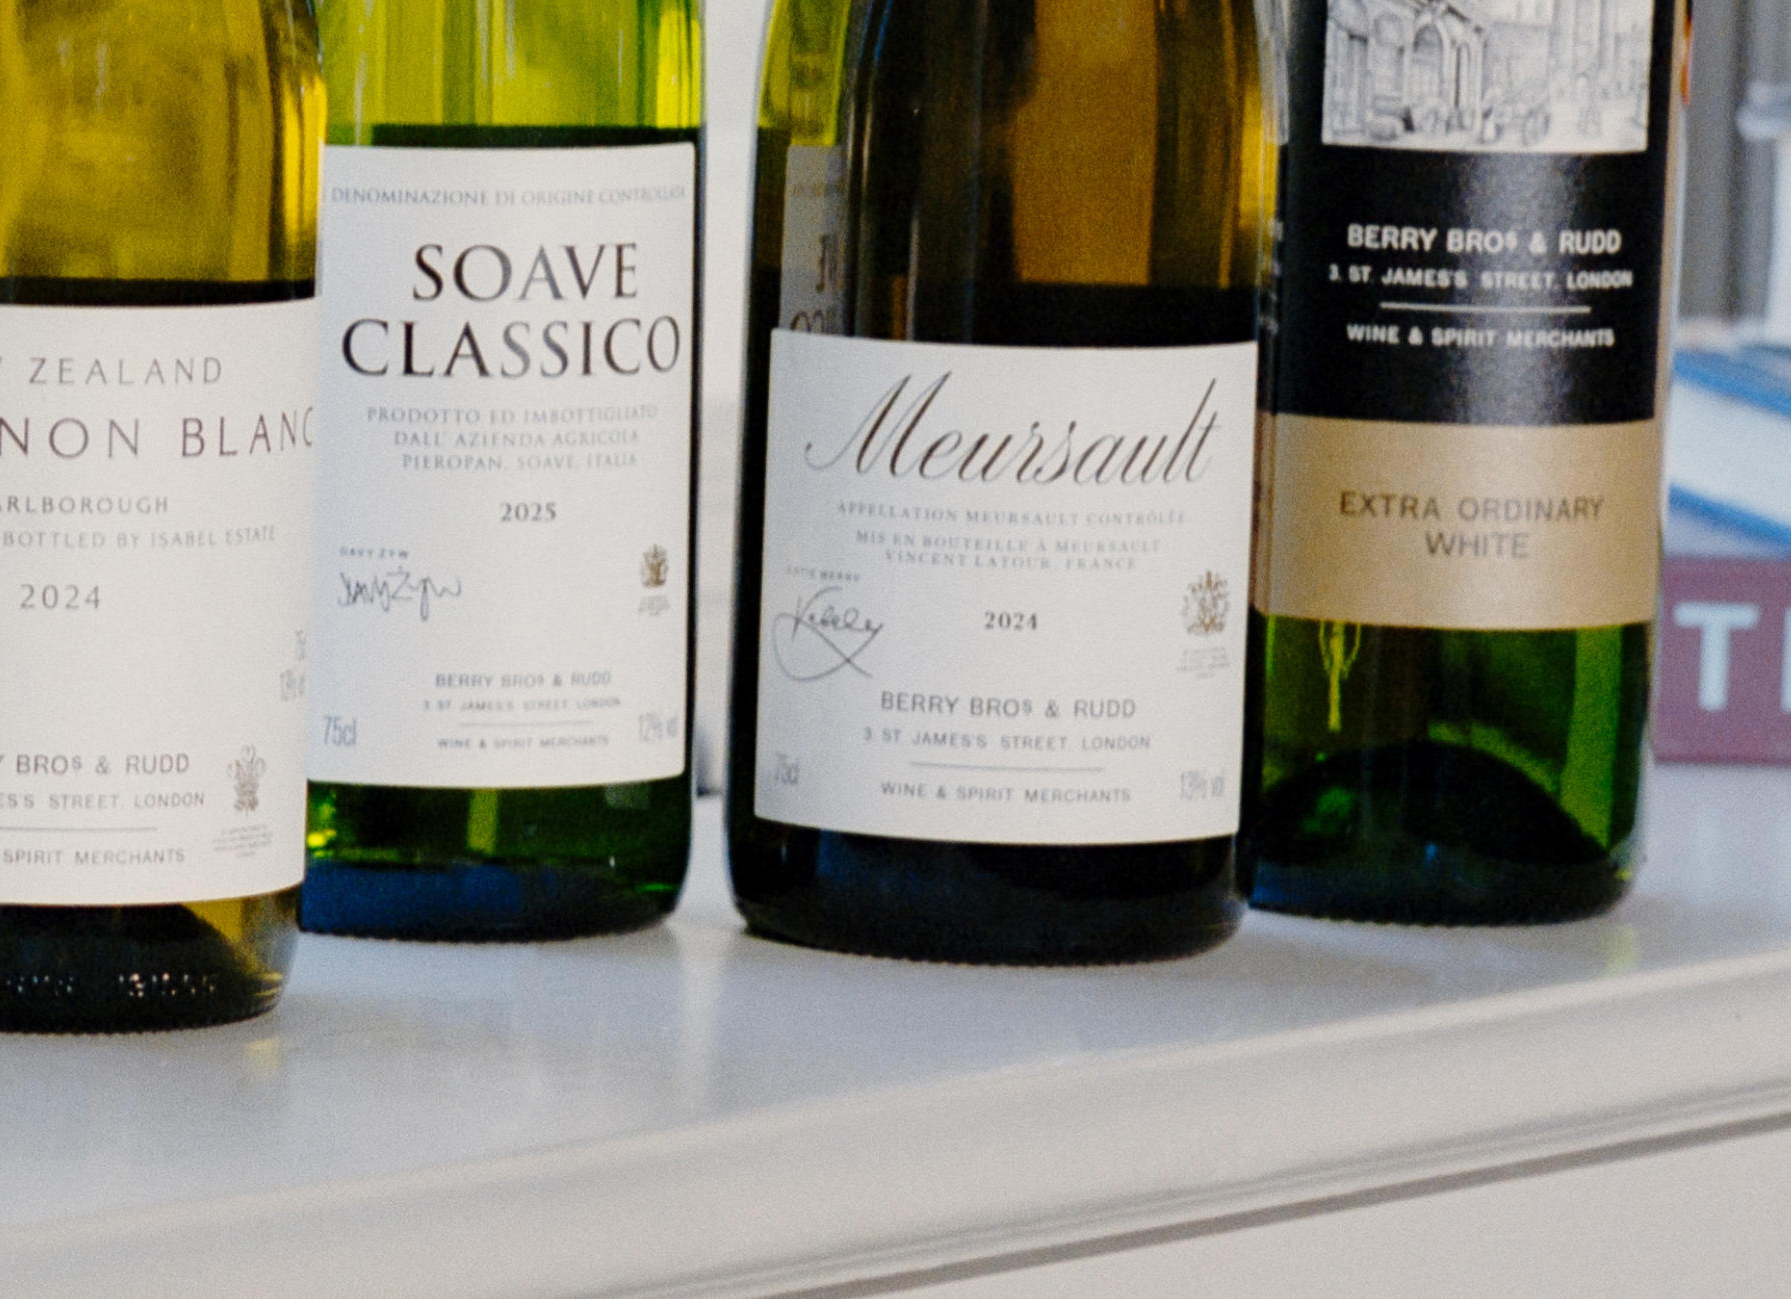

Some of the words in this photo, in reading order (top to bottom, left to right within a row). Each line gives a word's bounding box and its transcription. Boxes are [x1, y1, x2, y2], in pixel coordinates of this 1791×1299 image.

[331, 187, 488, 206] DENOMINAZIONE
[496, 190, 515, 206] DI
[521, 189, 595, 207] ORIGINE
[599, 184, 686, 203] CONTROLLATA
[1347, 223, 1438, 252] BERRY
[1529, 232, 1546, 254] &
[1559, 230, 1622, 254] RUDD
[413, 242, 638, 301] SOAVE
[1567, 270, 1633, 289] LONDON
[341, 315, 681, 378] CLASSICO
[1347, 324, 1399, 344] WINE
[1409, 326, 1423, 345] &
[1431, 327, 1496, 346] SPIRIT
[1506, 329, 1615, 347] MERCHANTS
[29, 357, 222, 385] ZEALAND
[367, 406, 480, 425] PRODOTTO
[490, 410, 515, 424] ED
[524, 404, 658, 424] IMBOTTIGLIATO
[181, 406, 313, 458] BLANC
[455, 432, 545, 447] AZIENDA
[552, 429, 639, 446] AGRICOLA
[805, 371, 1221, 485] Meursault
[586, 452, 638, 468] ITALIA
[500, 502, 557, 523] 2025
[837, 499, 958, 522] APPELLATION
[966, 509, 1078, 526] MEURSAULT
[1340, 491, 1442, 521] EXTRA
[1458, 497, 1604, 523] ORDINARY
[3, 530, 106, 548] BOTTLED
[117, 531, 139, 548] BY
[150, 530, 218, 547] ISABEL
[225, 526, 275, 545] ESTATE
[856, 530, 886, 544] MIS
[893, 533, 915, 546] EN
[923, 534, 1028, 552] BOUTEILLE
[1055, 538, 1161, 553] MEURSAULT
[1425, 532, 1529, 559] WHITE
[886, 552, 966, 566] VINCENT
[1066, 556, 1136, 570] FRANCE
[20, 584, 102, 609] 2024
[984, 612, 1038, 630] 2024
[434, 673, 493, 688] BERRY
[552, 675, 562, 688] &
[571, 671, 612, 686] RUDD
[577, 697, 621, 709] LONDON
[881, 691, 958, 714] BERRY
[1045, 699, 1059, 717] &
[1074, 699, 1136, 718] RUDD
[322, 714, 358, 747] 75cl
[438, 738, 470, 749] WINE
[479, 739, 487, 749] &
[493, 738, 532, 748] SPIRIT
[540, 735, 610, 748] MERCHANTS
[1082, 735, 1151, 750] LONDON
[95, 756, 111, 775] &
[126, 753, 190, 775] RUDD
[133, 791, 205, 808] LONDON
[881, 782, 927, 796] WINE
[937, 785, 947, 798] &
[957, 787, 1012, 801] SPIRIT
[1025, 788, 1131, 802] MERCHANTS
[4, 849, 63, 865] SPIRIT
[75, 847, 186, 865] MERCHANTS
